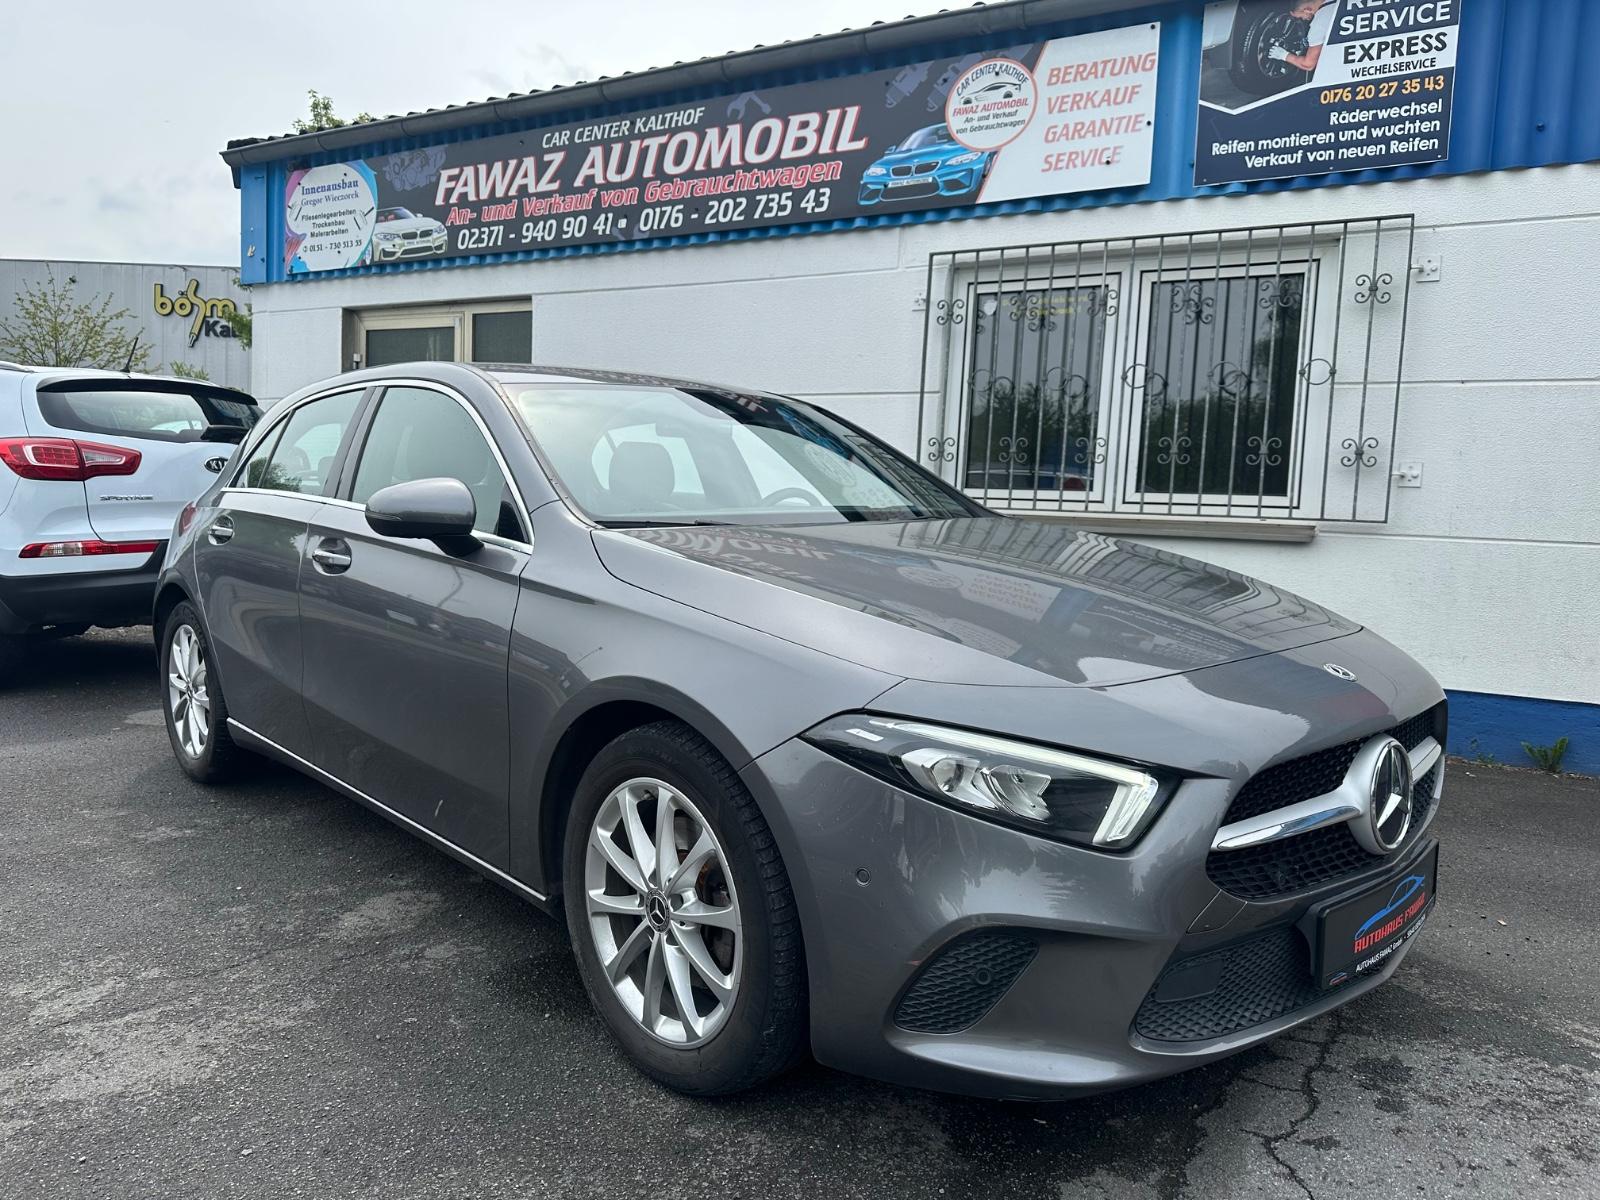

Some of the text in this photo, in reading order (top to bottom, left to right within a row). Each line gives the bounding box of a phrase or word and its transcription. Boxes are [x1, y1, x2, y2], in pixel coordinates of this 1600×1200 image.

[1339, 1, 1451, 36] SERVICE
[1343, 31, 1448, 65] EXPRESS
[956, 63, 1029, 96] CAR CENTER KALTHOF
[1046, 52, 1156, 86] BERATUNG
[1351, 57, 1437, 78] WECHELSERVICE
[1047, 84, 1142, 115] VERKAUF
[1320, 75, 1444, 105] 0176 20 27 35 43
[952, 97, 1029, 117] FAWAZ AUTOMOBIL
[992, 109, 1018, 119] Verkauf
[1329, 98, 1443, 126] Räderwechsel
[542, 107, 706, 149] CAR CENTER KALTHOF
[969, 119, 1026, 133] Gebrauchtwagen
[1044, 113, 1145, 144] GARANTIE
[1211, 119, 1441, 156] Reifen montieren und wuchten
[435, 105, 869, 206] FAWAZ AUTOMOBIL
[1041, 145, 1124, 173] SERVICE
[1244, 137, 1439, 169] Verkauf von neuen Reifen
[302, 179, 359, 195] Innenausbau
[446, 160, 843, 226] An- und Verkauf von Gebrauchtwagen
[457, 225, 505, 249] 02371
[521, 219, 557, 243] 940
[562, 215, 588, 239] 90
[639, 205, 684, 231] 0176
[704, 197, 747, 225] 202
[753, 191, 793, 219] 735
[800, 187, 831, 214] 43
[1354, 914, 1404, 954] AUTOHAUS
